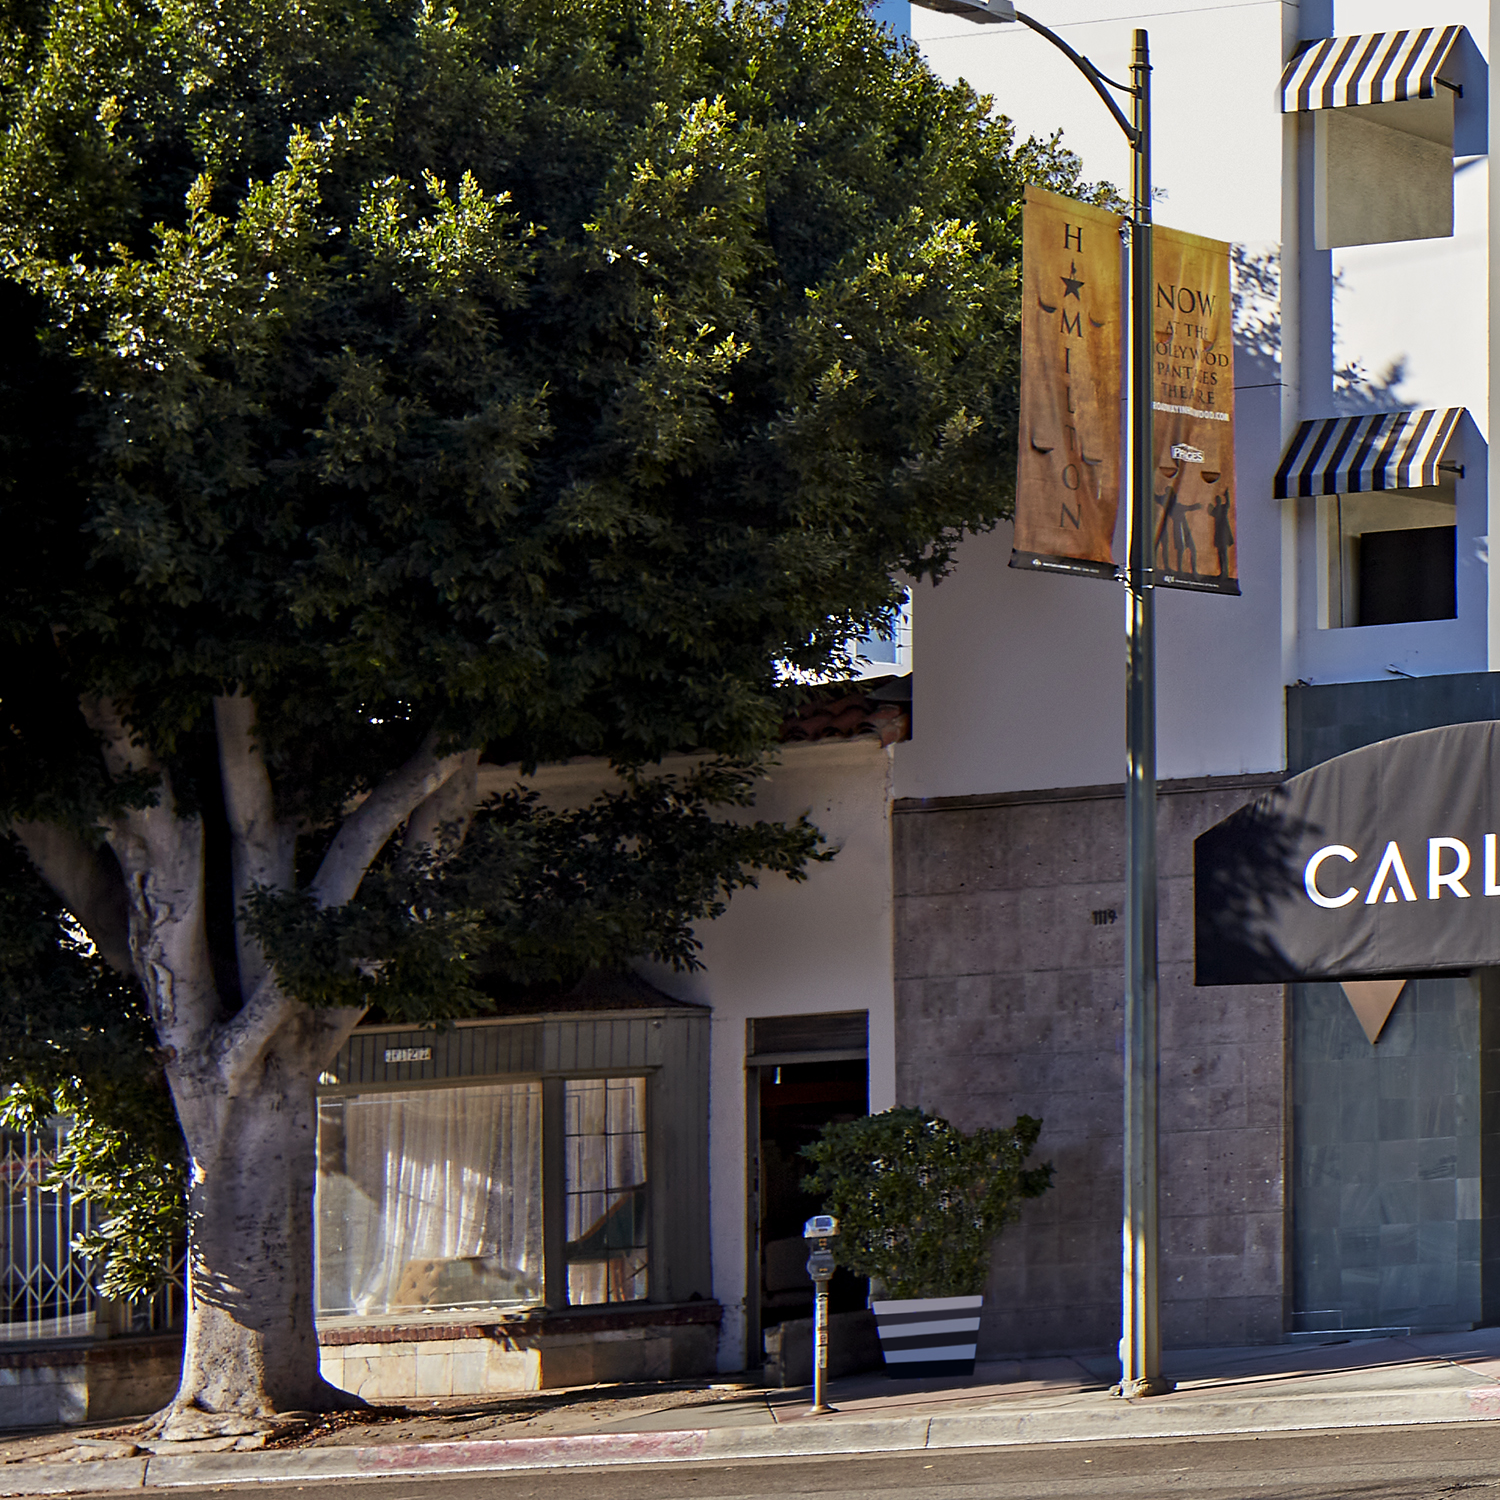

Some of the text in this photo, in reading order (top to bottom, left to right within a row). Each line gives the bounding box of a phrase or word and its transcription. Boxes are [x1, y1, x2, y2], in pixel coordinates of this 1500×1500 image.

[1156, 283, 1216, 317] NOW
[1166, 321, 1208, 340] AT THE
[1156, 342, 1229, 367] OLLYWOD
[1157, 362, 1218, 386] PANTES
[1161, 382, 1215, 404] THEARE
[1092, 909, 1118, 926] 1119
